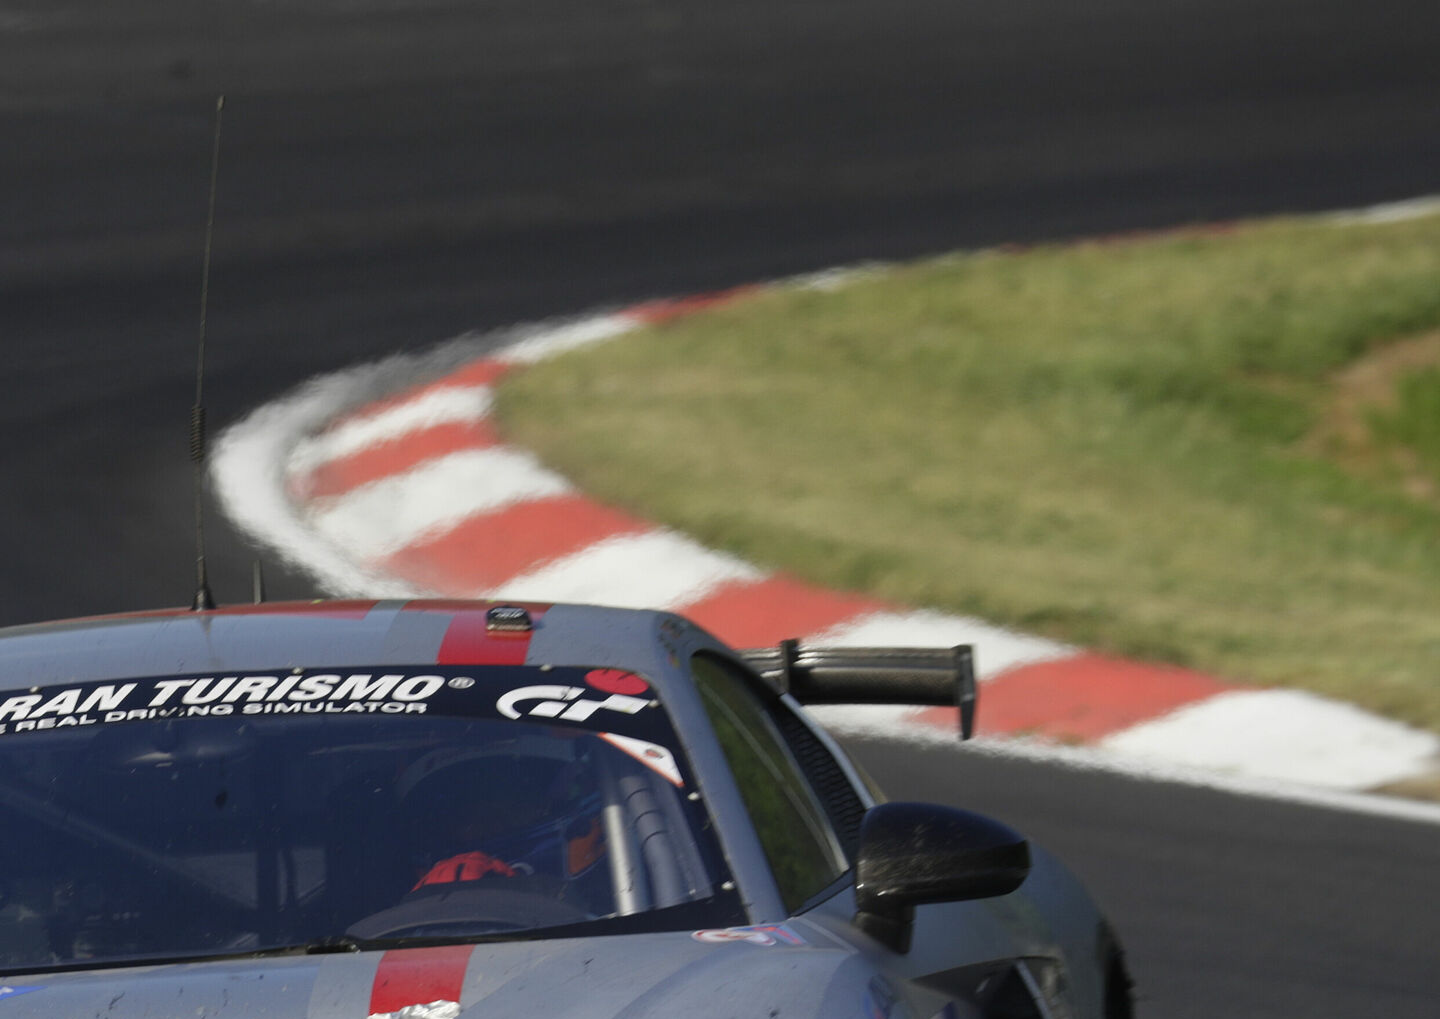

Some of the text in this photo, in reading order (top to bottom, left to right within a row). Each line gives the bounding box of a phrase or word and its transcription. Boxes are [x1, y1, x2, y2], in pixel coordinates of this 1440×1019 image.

[148, 674, 446, 707] TURISMO
[15, 714, 98, 733] REAL
[242, 701, 428, 716] SIMULATOR
